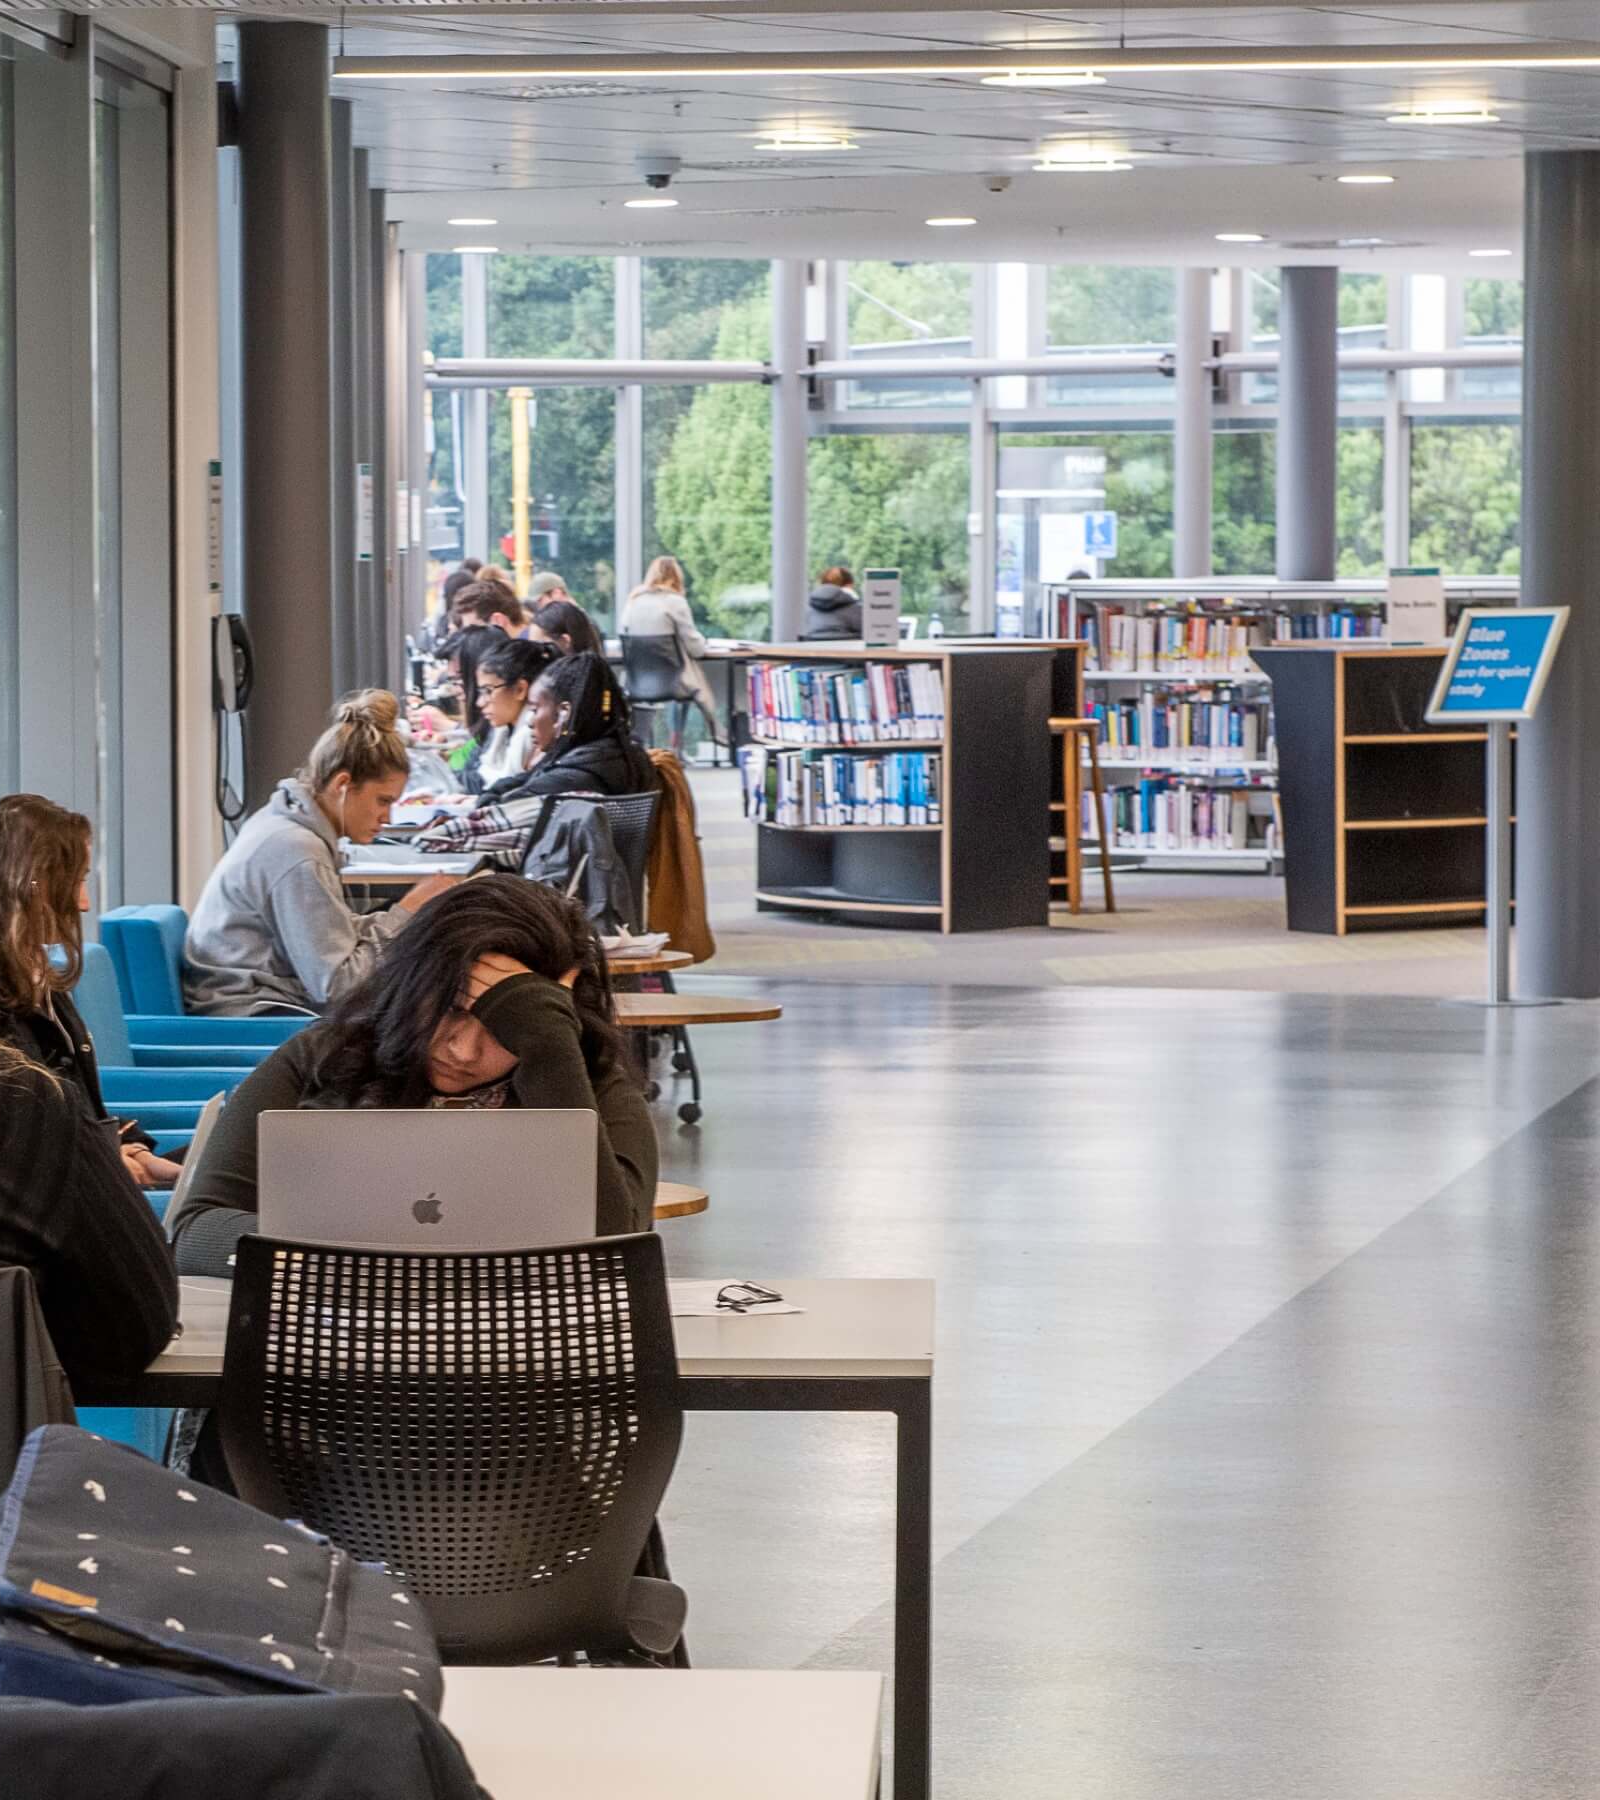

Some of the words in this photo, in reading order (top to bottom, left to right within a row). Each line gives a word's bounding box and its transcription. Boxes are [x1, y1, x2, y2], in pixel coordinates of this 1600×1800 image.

[1468, 627, 1506, 642] Blue
[1462, 647, 1509, 661] Zones
[1454, 668, 1476, 678] are
[1477, 665, 1496, 677] for
[1497, 665, 1531, 680] quiet
[1449, 683, 1485, 698] study
